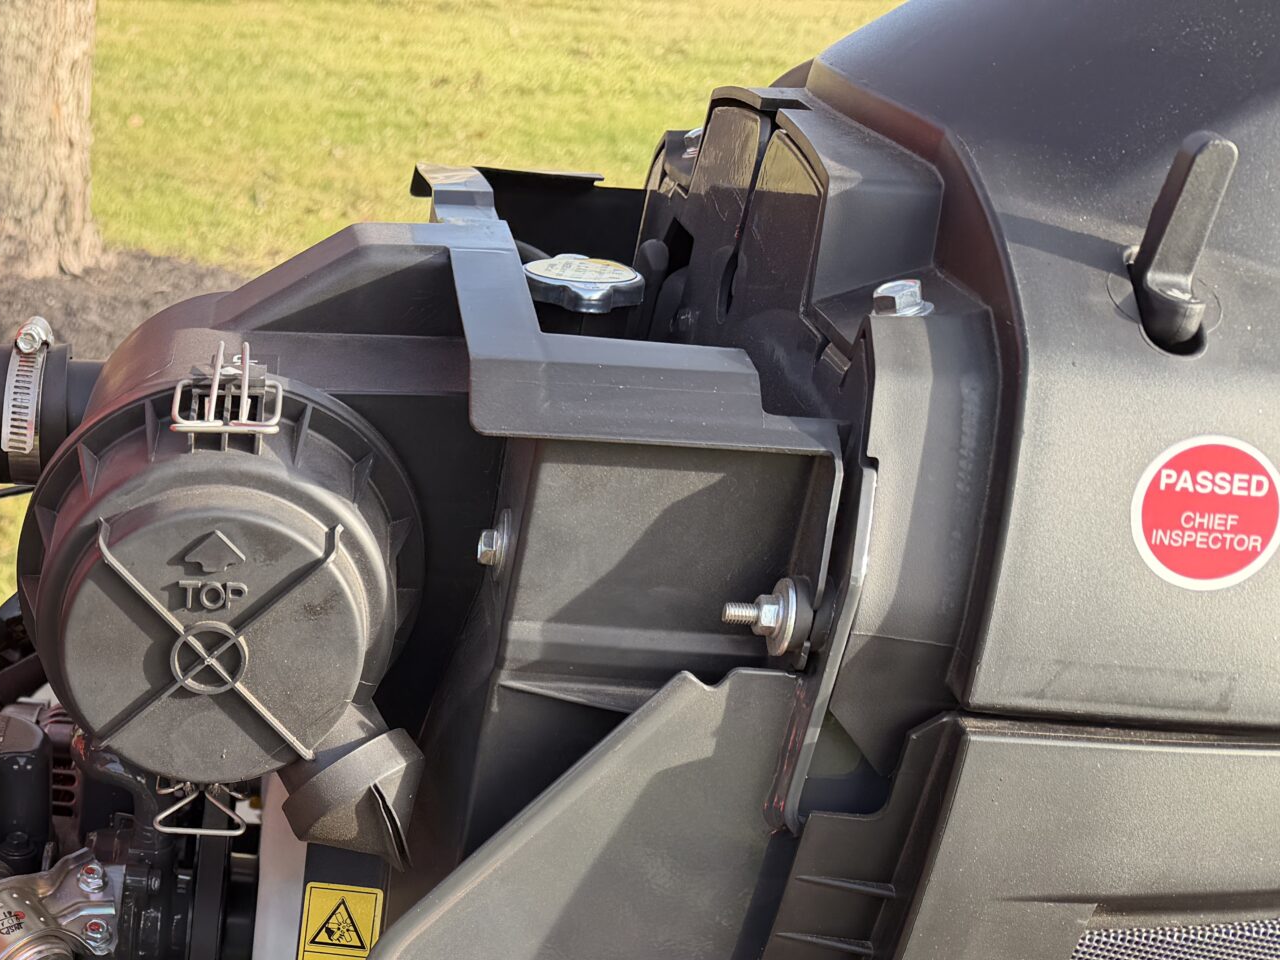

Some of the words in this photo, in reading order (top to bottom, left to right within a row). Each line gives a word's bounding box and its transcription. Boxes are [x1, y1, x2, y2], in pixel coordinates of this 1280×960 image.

[1160, 469, 1270, 497] PASSED
[1181, 511, 1239, 530] CHIEF
[1151, 529, 1262, 552] INSPECTOR
[178, 580, 248, 610] TOP
